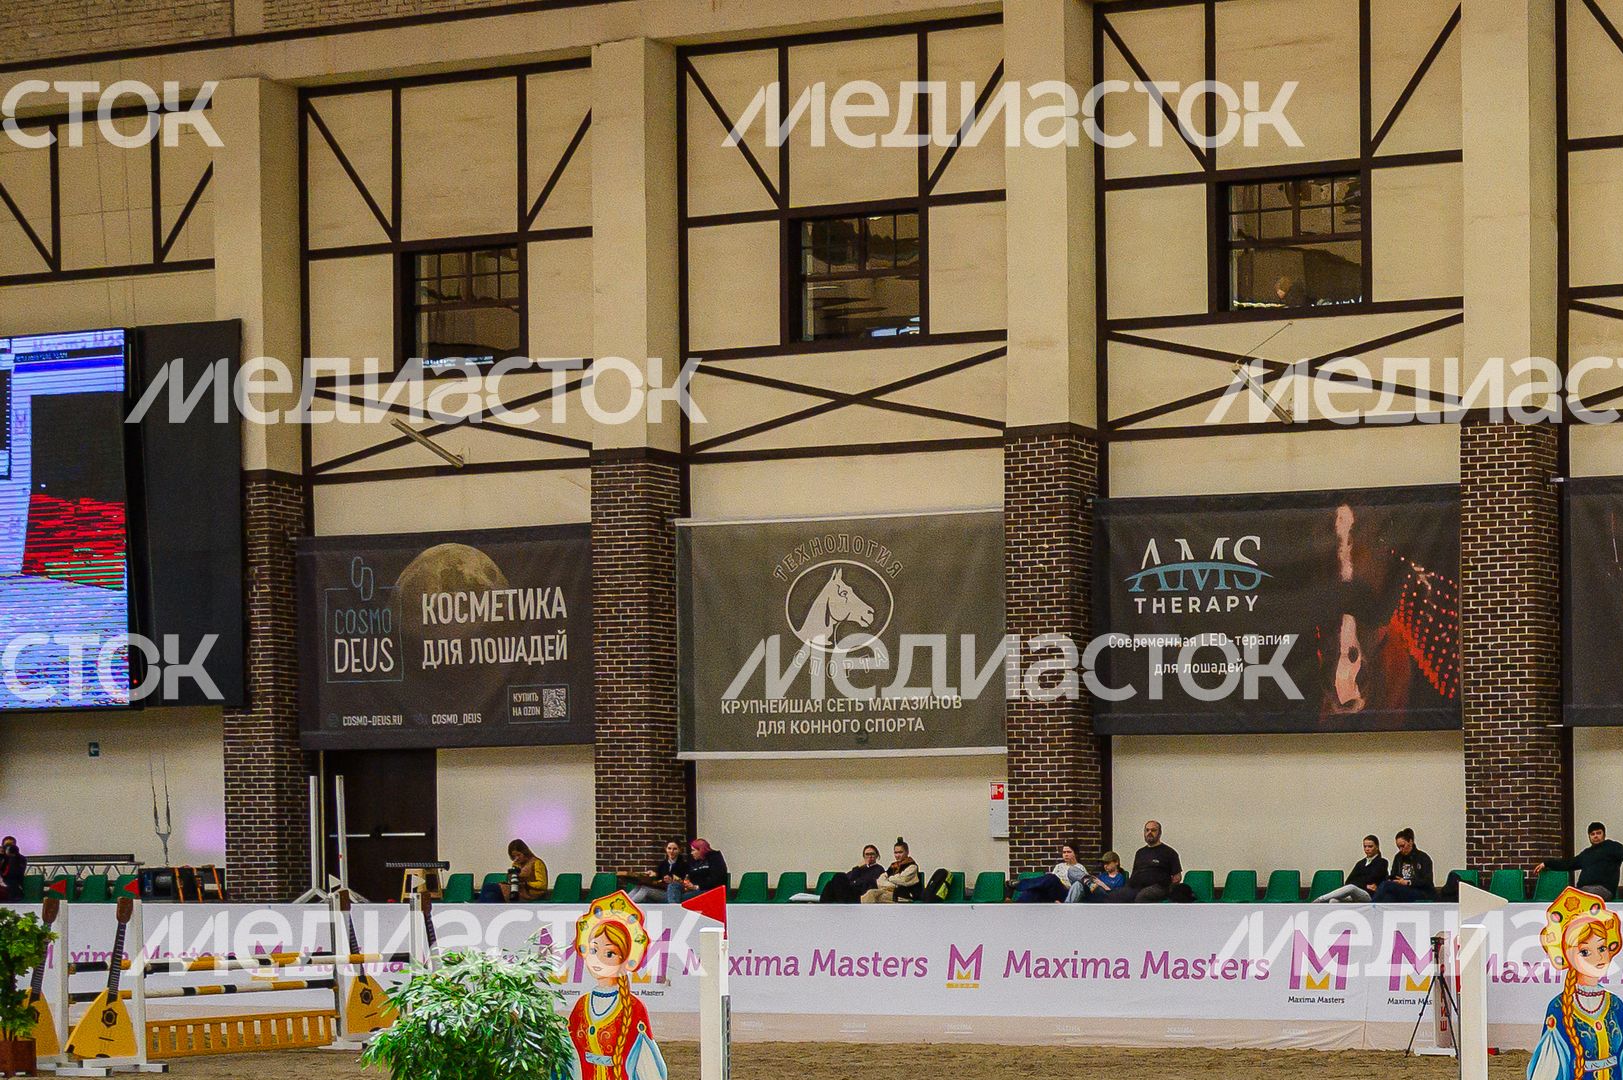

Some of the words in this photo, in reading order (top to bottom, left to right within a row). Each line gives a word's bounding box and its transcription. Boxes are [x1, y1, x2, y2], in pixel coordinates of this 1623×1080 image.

[774, 534, 904, 582] ТЕХНОЛОГИЯ
[1128, 536, 1263, 592] AMS
[422, 587, 567, 624] КОСМЕТИКА
[1134, 595, 1258, 614] THERAPY
[335, 609, 392, 635] COSMO
[422, 639, 463, 669] ДЛЯ
[469, 630, 567, 666] ЛОШАДЕЙ
[1108, 634, 1196, 651] Современная
[1201, 633, 1290, 649] LED-терапия
[334, 638, 394, 673] DEUS
[792, 647, 889, 678] СПОРТА
[1154, 664, 1178, 676] для
[1183, 658, 1243, 675] лошадей
[513, 692, 539, 703] КУПИТЬ
[721, 697, 823, 714] КРУПНЕЙШАЯ
[827, 698, 864, 712] СЕТЬ
[869, 696, 961, 712] МАГАЗИНОВ
[432, 713, 482, 726] COSMO_DEUS
[513, 707, 521, 717] НА
[523, 706, 541, 716] OZON
[757, 721, 785, 737] ДЛЯ
[790, 719, 860, 734] КОННОГО
[865, 717, 925, 733] СПОРТА
[682, 948, 800, 977] Mxima
[808, 948, 928, 978] Masters
[1003, 950, 1130, 979] Maxima
[1140, 950, 1270, 980] Masters
[1288, 996, 1316, 1004] Maxima
[1317, 995, 1345, 1005] Masters
